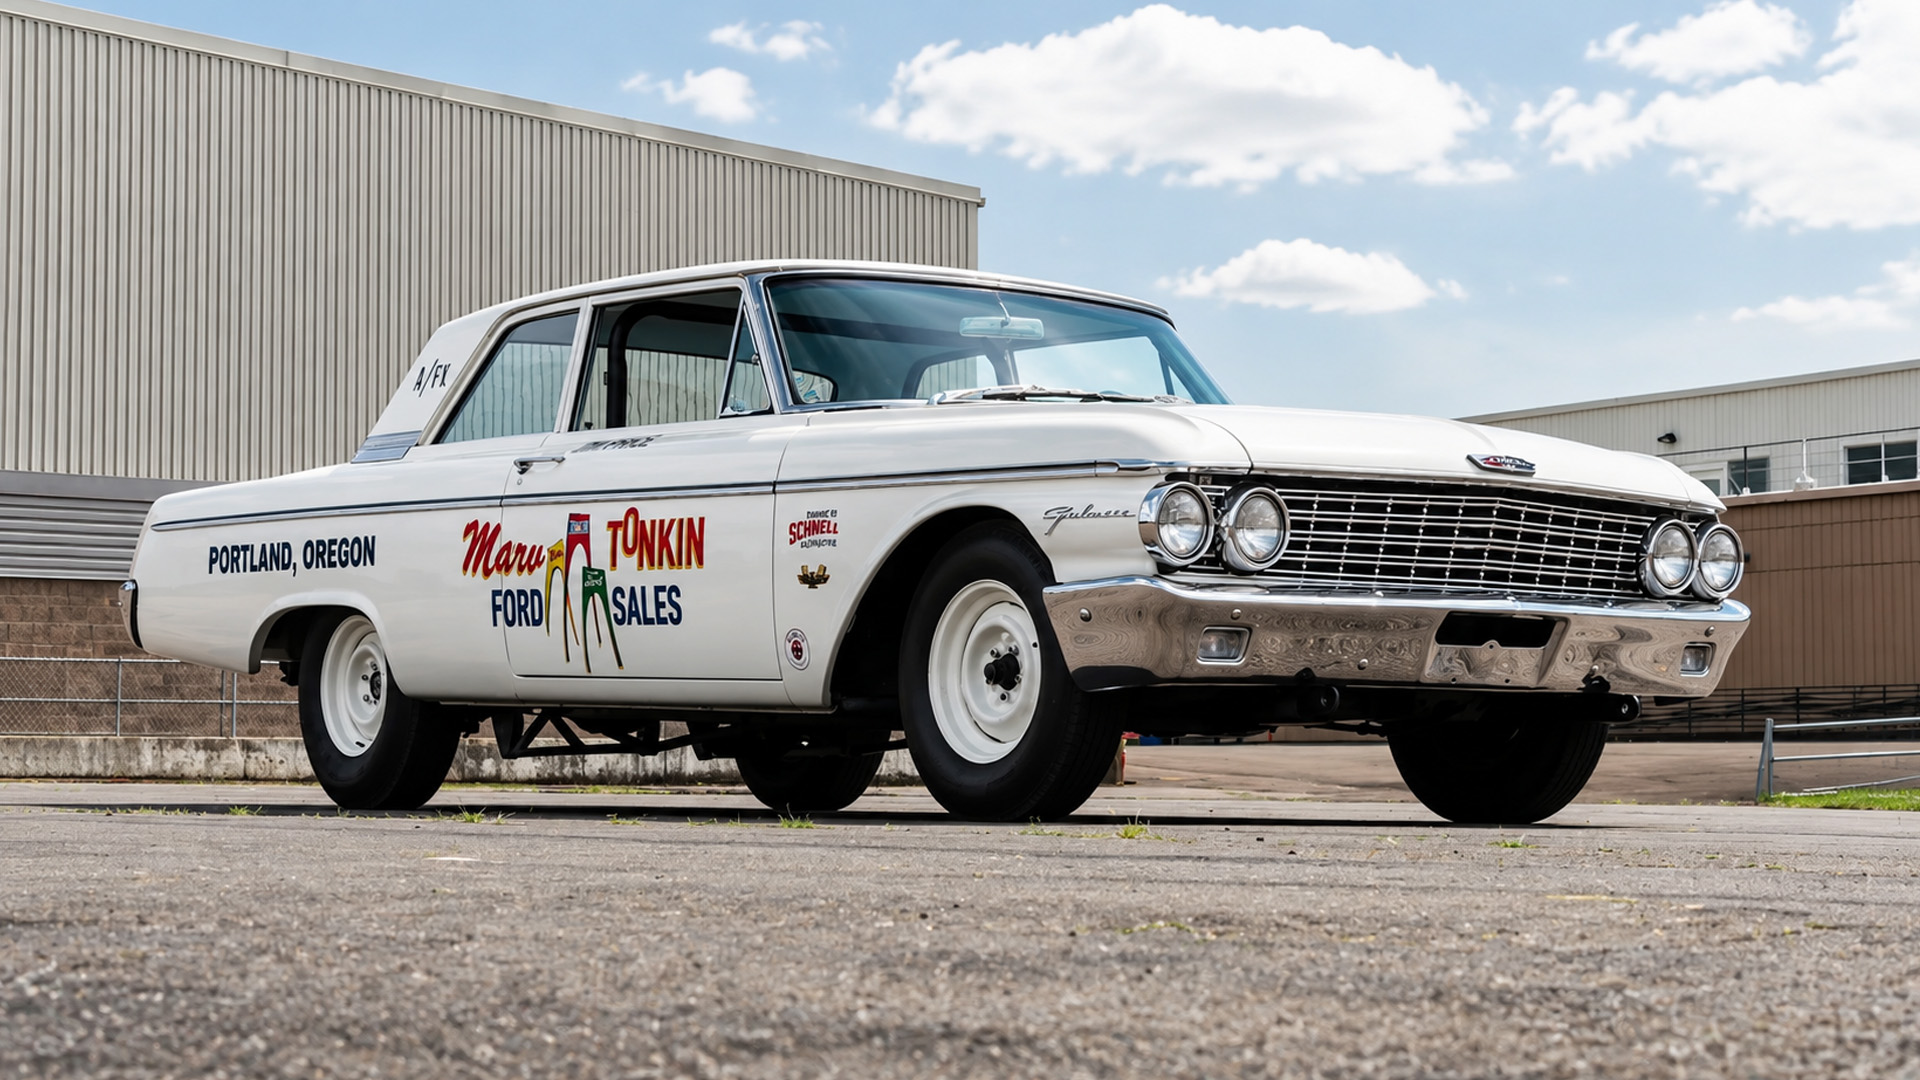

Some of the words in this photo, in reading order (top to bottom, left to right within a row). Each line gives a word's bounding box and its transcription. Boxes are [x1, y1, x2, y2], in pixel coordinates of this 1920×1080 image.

[606, 506, 705, 571] TONKIN
[789, 519, 839, 545] SCHNELL
[208, 542, 297, 577] PORTLAND,
[303, 535, 376, 570] OREGON
[491, 588, 543, 628] FORD
[612, 585, 682, 626] SALES
